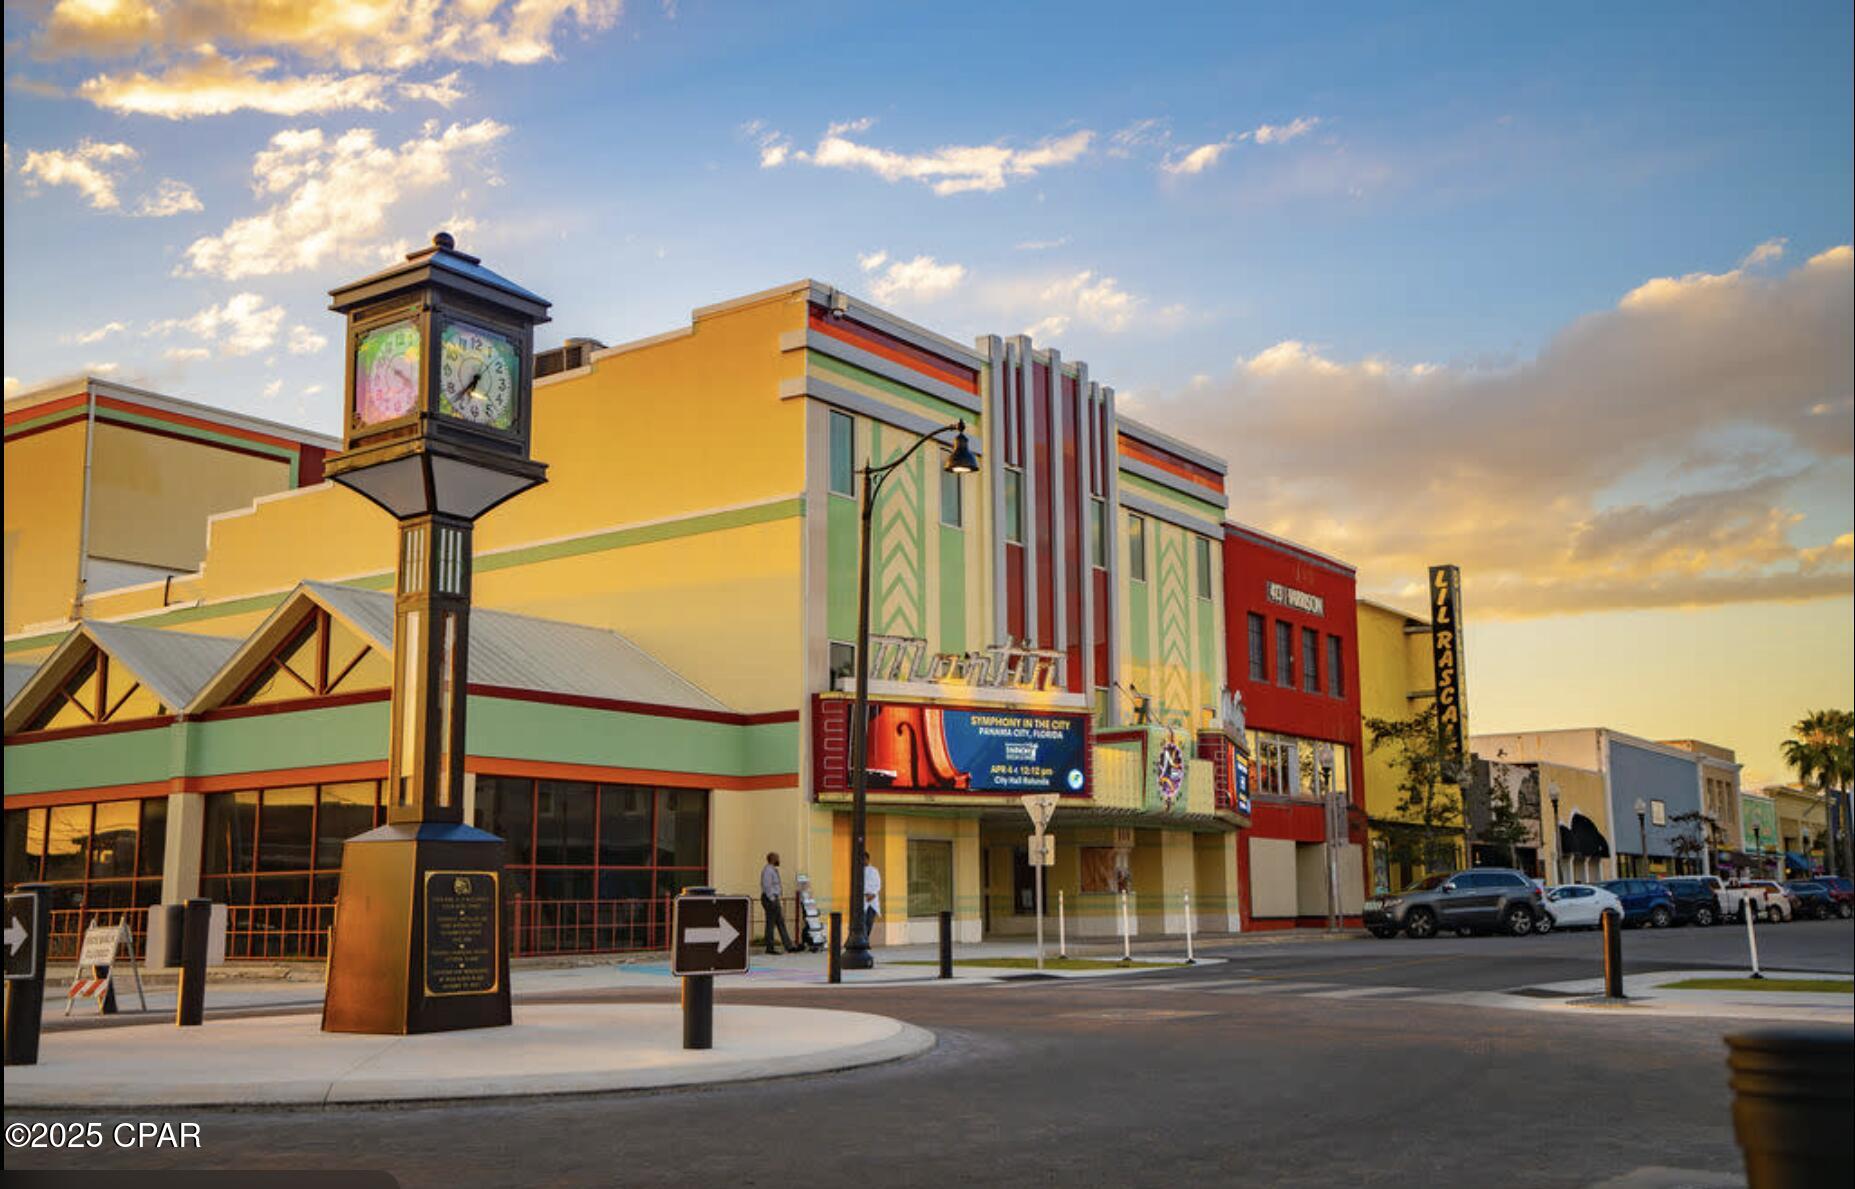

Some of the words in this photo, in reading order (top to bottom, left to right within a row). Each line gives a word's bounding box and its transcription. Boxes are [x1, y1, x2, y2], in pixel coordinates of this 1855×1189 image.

[471, 336, 482, 350] 12
[495, 361, 503, 374] 2
[447, 382, 455, 394] 8
[499, 378, 507, 392] 3
[486, 403, 494, 417] 5
[971, 715, 1021, 728] SYMPHONY
[1023, 718, 1033, 728] IN
[1035, 719, 1050, 730] THE
[1051, 720, 1071, 731] CITY
[979, 727, 1012, 736] PANAMA
[1033, 729, 1064, 739] FLORIDA
[990, 764, 1007, 774] APR
[1041, 767, 1054, 777] pm
[993, 776, 1008, 786] City
[1009, 776, 1022, 785] Hall
